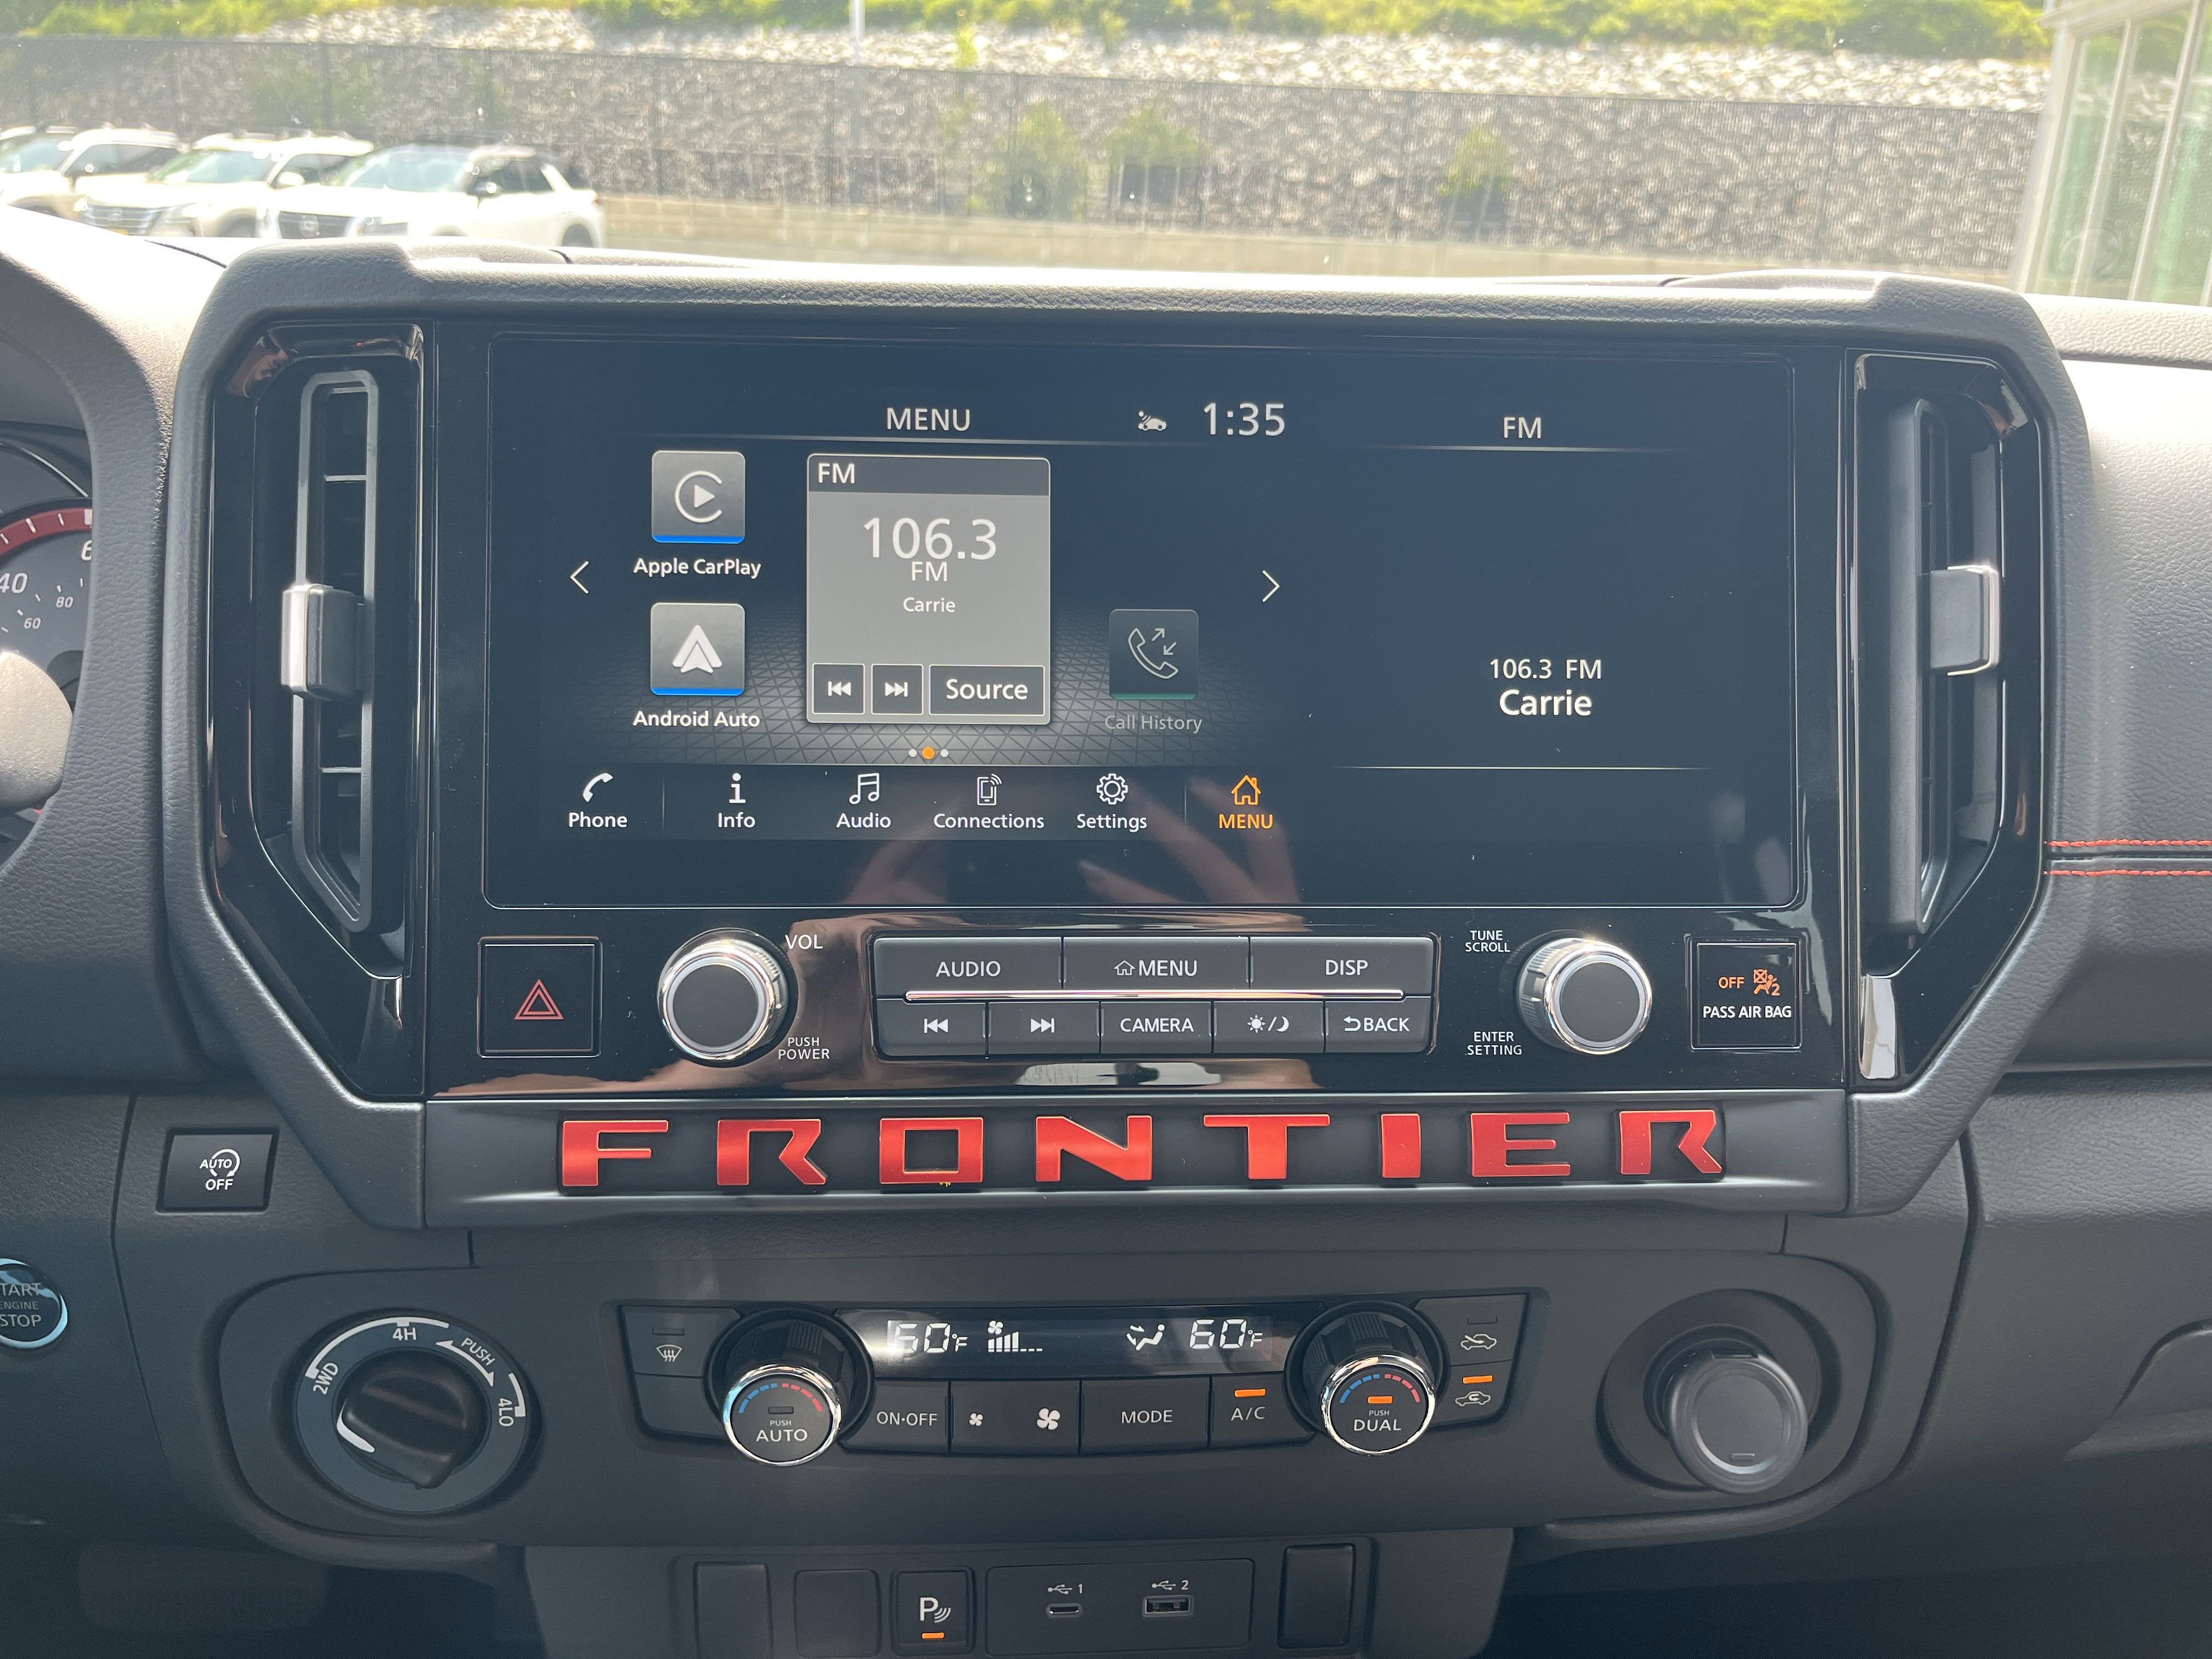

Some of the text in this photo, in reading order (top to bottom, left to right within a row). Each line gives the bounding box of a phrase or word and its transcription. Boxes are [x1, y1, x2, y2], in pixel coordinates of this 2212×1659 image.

[887, 408, 970, 431] MENU
[1204, 403, 1285, 437] 1:35
[1503, 417, 1542, 439] FM
[818, 462, 855, 484] FM
[864, 517, 997, 560] 106.3
[633, 557, 761, 579] Apple CarPlay
[911, 561, 947, 582] FM
[0, 572, 28, 594] 40
[56, 596, 74, 608] 80
[903, 597, 956, 612] Carrie
[24, 617, 41, 629] 60
[1490, 659, 1602, 680] 106.3 FM
[946, 679, 1029, 700] Source
[1499, 689, 1593, 716] Carrie
[633, 710, 760, 727] Android Auto
[1104, 715, 1203, 733] Call History
[568, 812, 628, 828] Phone
[718, 812, 756, 829] Info
[836, 812, 891, 829] Audio
[933, 813, 1045, 829] Connections
[1076, 814, 1148, 833] Settings
[1219, 814, 1274, 830] MENU
[785, 934, 823, 950] VOL
[1470, 930, 1503, 941] TUNE
[1465, 942, 1511, 953] SCROLL
[935, 960, 1002, 978] AUDIO
[1138, 960, 1198, 977] MENU
[1325, 960, 1369, 976] DISP
[1718, 976, 1745, 989] OFF
[1702, 1005, 1791, 1019] PASS AIR BAG
[1120, 1018, 1194, 1033] CAMERA
[1364, 1017, 1410, 1032] BACK
[788, 1036, 821, 1047] PUSH
[1474, 1031, 1514, 1042] ENTER
[778, 1049, 830, 1060] POWER
[1466, 1045, 1523, 1056] SETTING
[562, 1109, 1723, 1187] FRONTIER
[199, 1159, 233, 1169] AUTO
[205, 1178, 234, 1191] OFF
[0, 1283, 41, 1296] TART
[392, 1327, 417, 1341] 4H
[461, 1337, 495, 1366] PUSH
[313, 1362, 339, 1395] 2WD
[498, 1397, 514, 1427] 4LO
[1121, 1410, 1173, 1424] MODE
[1231, 1406, 1266, 1421] A/C
[1353, 1419, 1402, 1432] DUAL
[755, 1429, 809, 1442] AUTO
[1077, 1584, 1084, 1594] 1
[1181, 1580, 1189, 1591] 2
